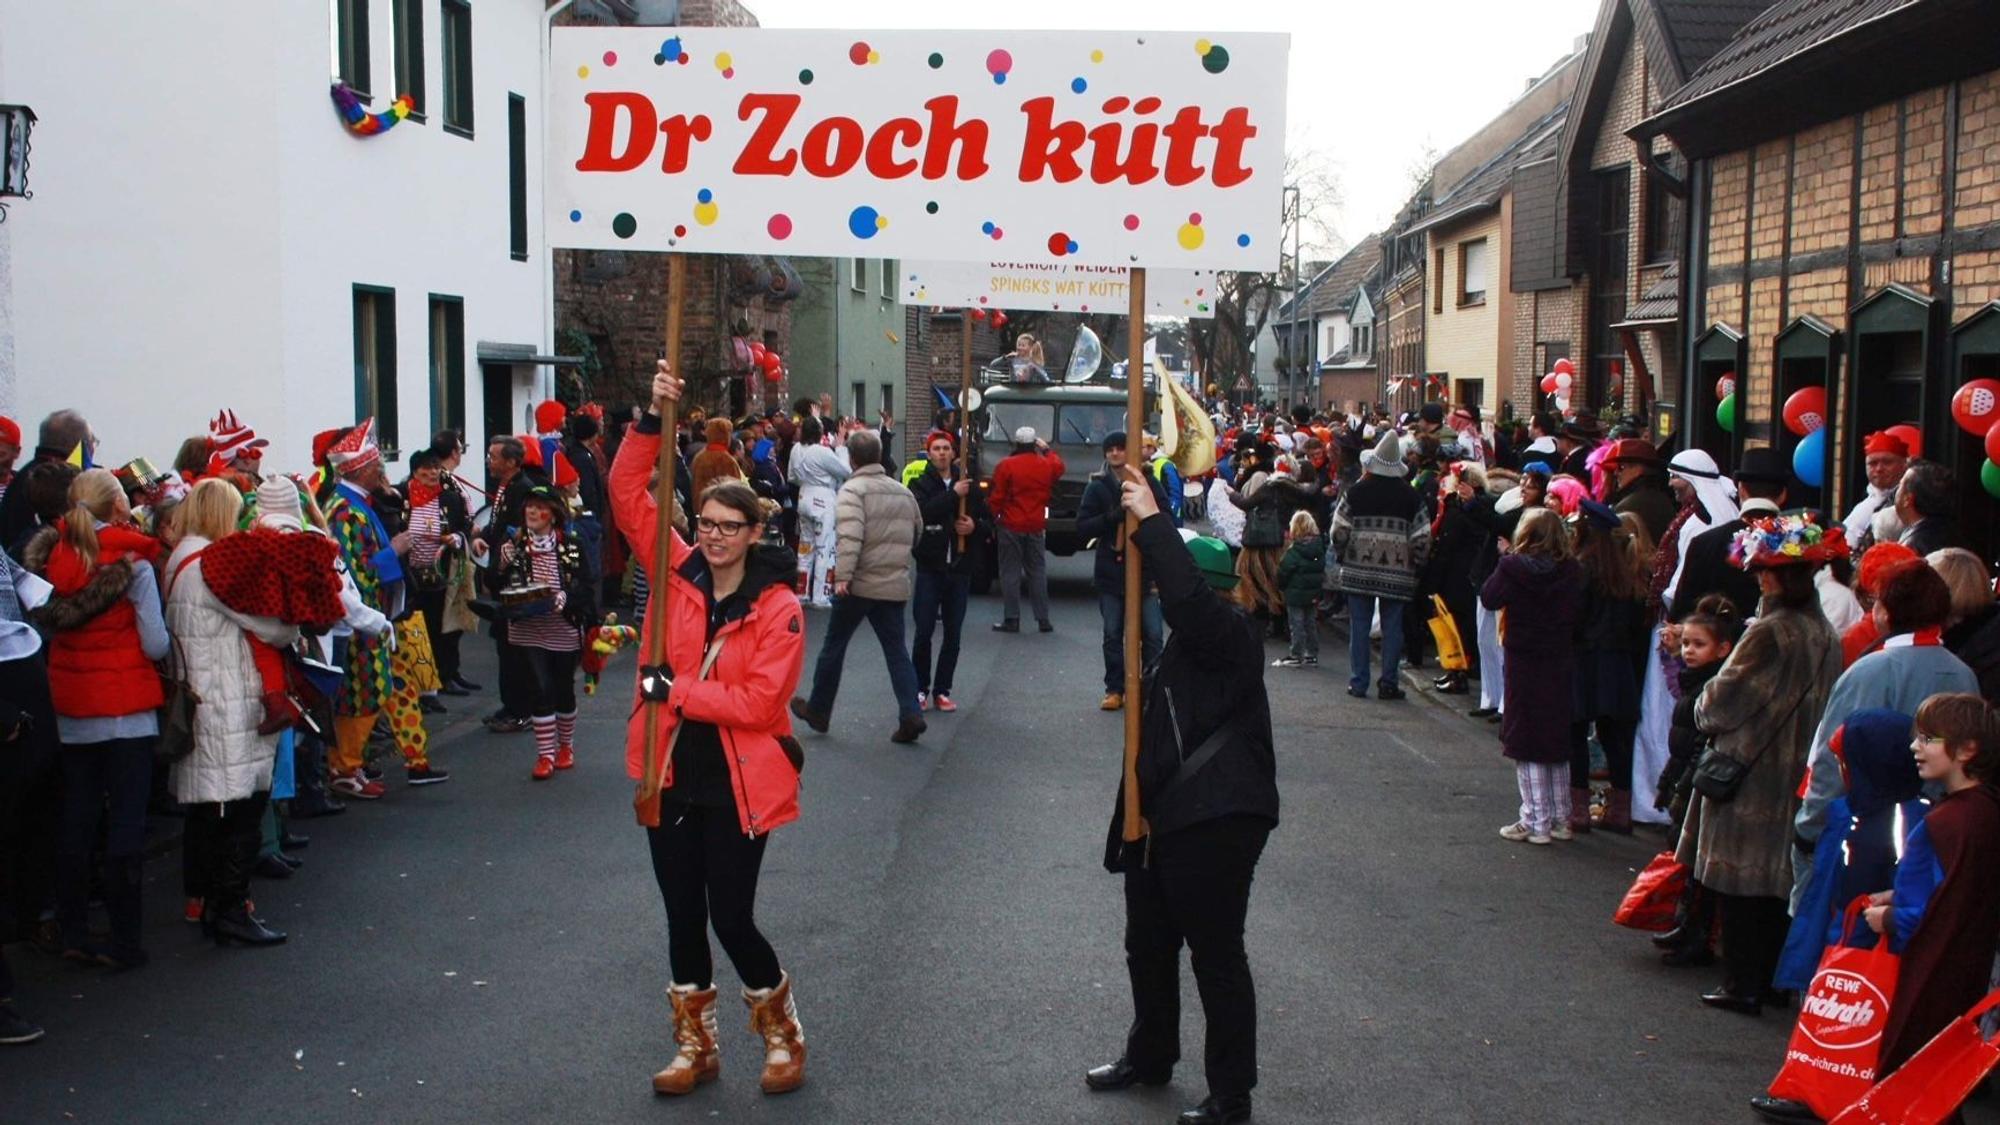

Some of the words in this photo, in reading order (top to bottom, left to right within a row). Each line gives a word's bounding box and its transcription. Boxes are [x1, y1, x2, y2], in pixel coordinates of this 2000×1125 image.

[576, 91, 713, 175] Dr
[733, 93, 989, 181] Zoch
[1019, 95, 1257, 188] kütt
[990, 276, 1050, 295] SPINGKS
[1055, 280, 1084, 296] WAT
[1825, 974, 1862, 994] REWE
